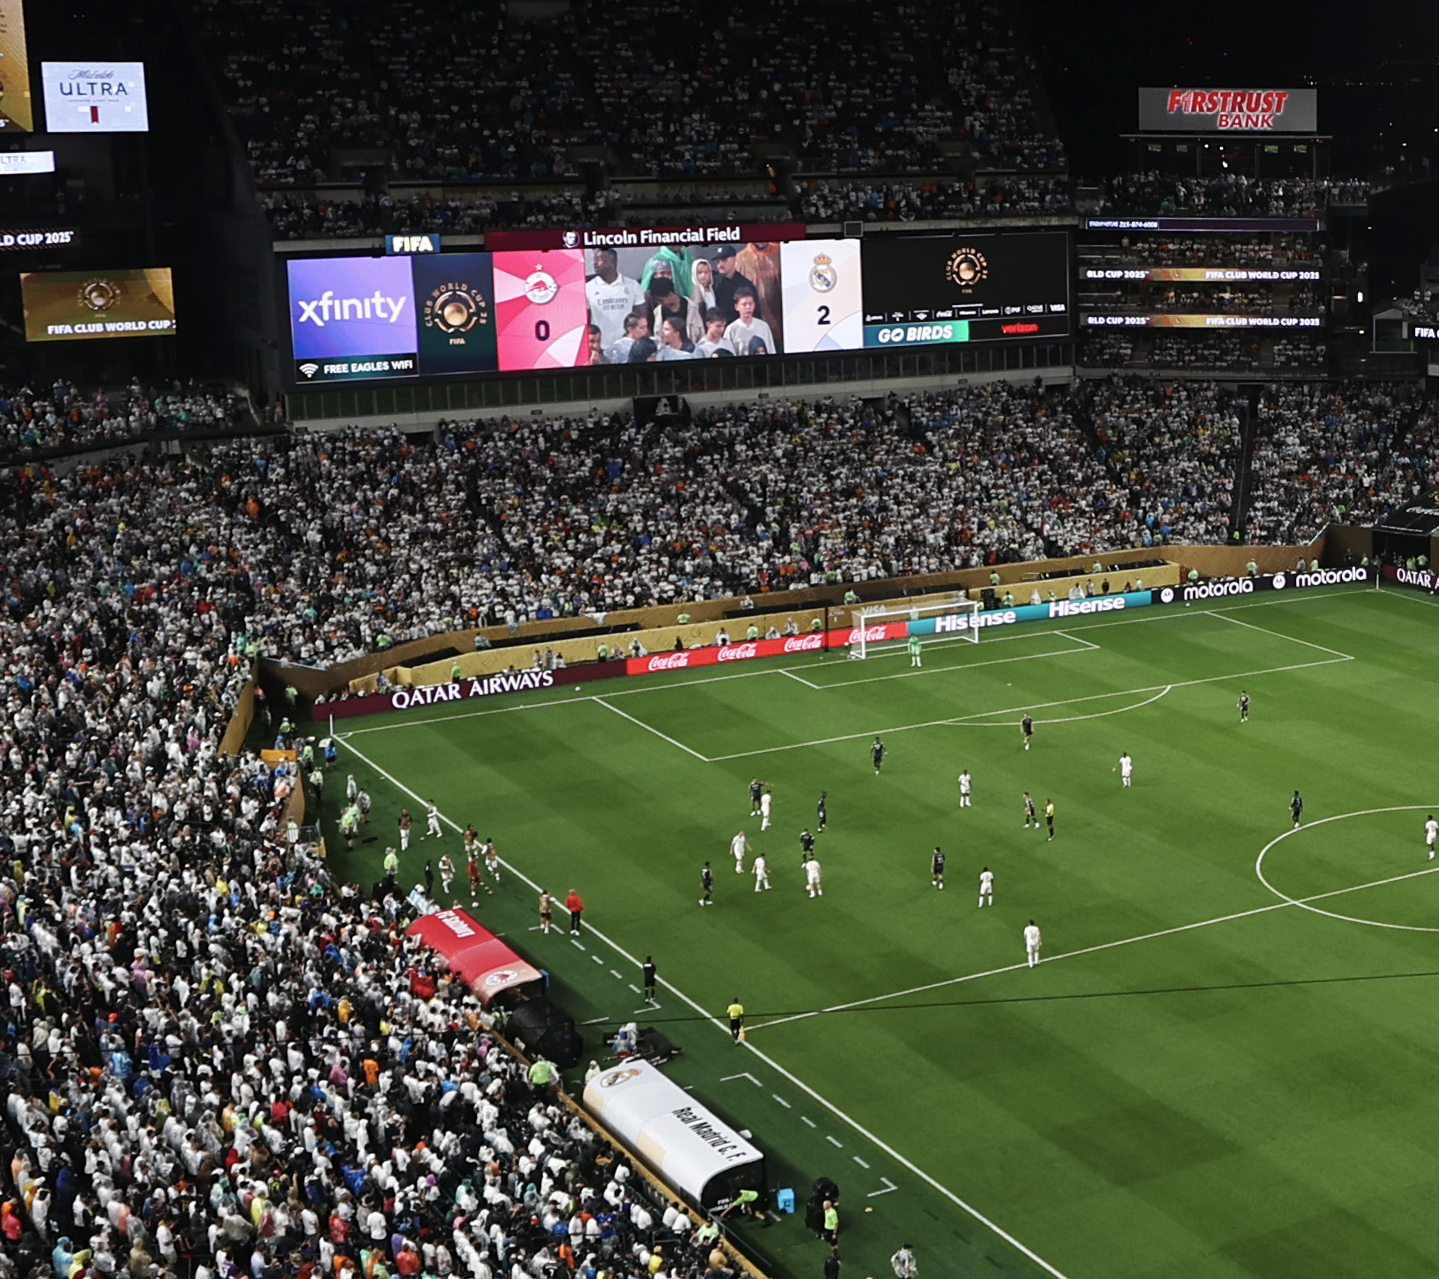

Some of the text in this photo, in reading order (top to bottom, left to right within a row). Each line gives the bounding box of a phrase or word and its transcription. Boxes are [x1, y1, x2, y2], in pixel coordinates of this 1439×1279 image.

[59, 82, 128, 96] ULTRA
[1216, 114, 1275, 129] BANK
[16, 233, 44, 246] CUP
[392, 236, 434, 253] FIFA
[583, 226, 740, 246] Lincoln Financial Field
[298, 290, 407, 327] xfinity
[817, 305, 831, 325] 2
[535, 320, 550, 341] 0
[907, 325, 953, 341] BIRDS
[1001, 323, 1039, 334] verizon
[323, 359, 413, 375] FREE EAGLES WIFI
[1183, 566, 1367, 600] motorola motorola
[1396, 567, 1431, 589] QATAR
[935, 594, 1125, 633] Hisense Hisense
[648, 651, 689, 672] Coca-Cola
[717, 643, 757, 662] Coca-Cola
[783, 633, 824, 653] Coca-Cola
[391, 669, 554, 709] QATAR AIRWAYS
[671, 1106, 703, 1125] Real
[689, 1121, 731, 1148] Madrid
